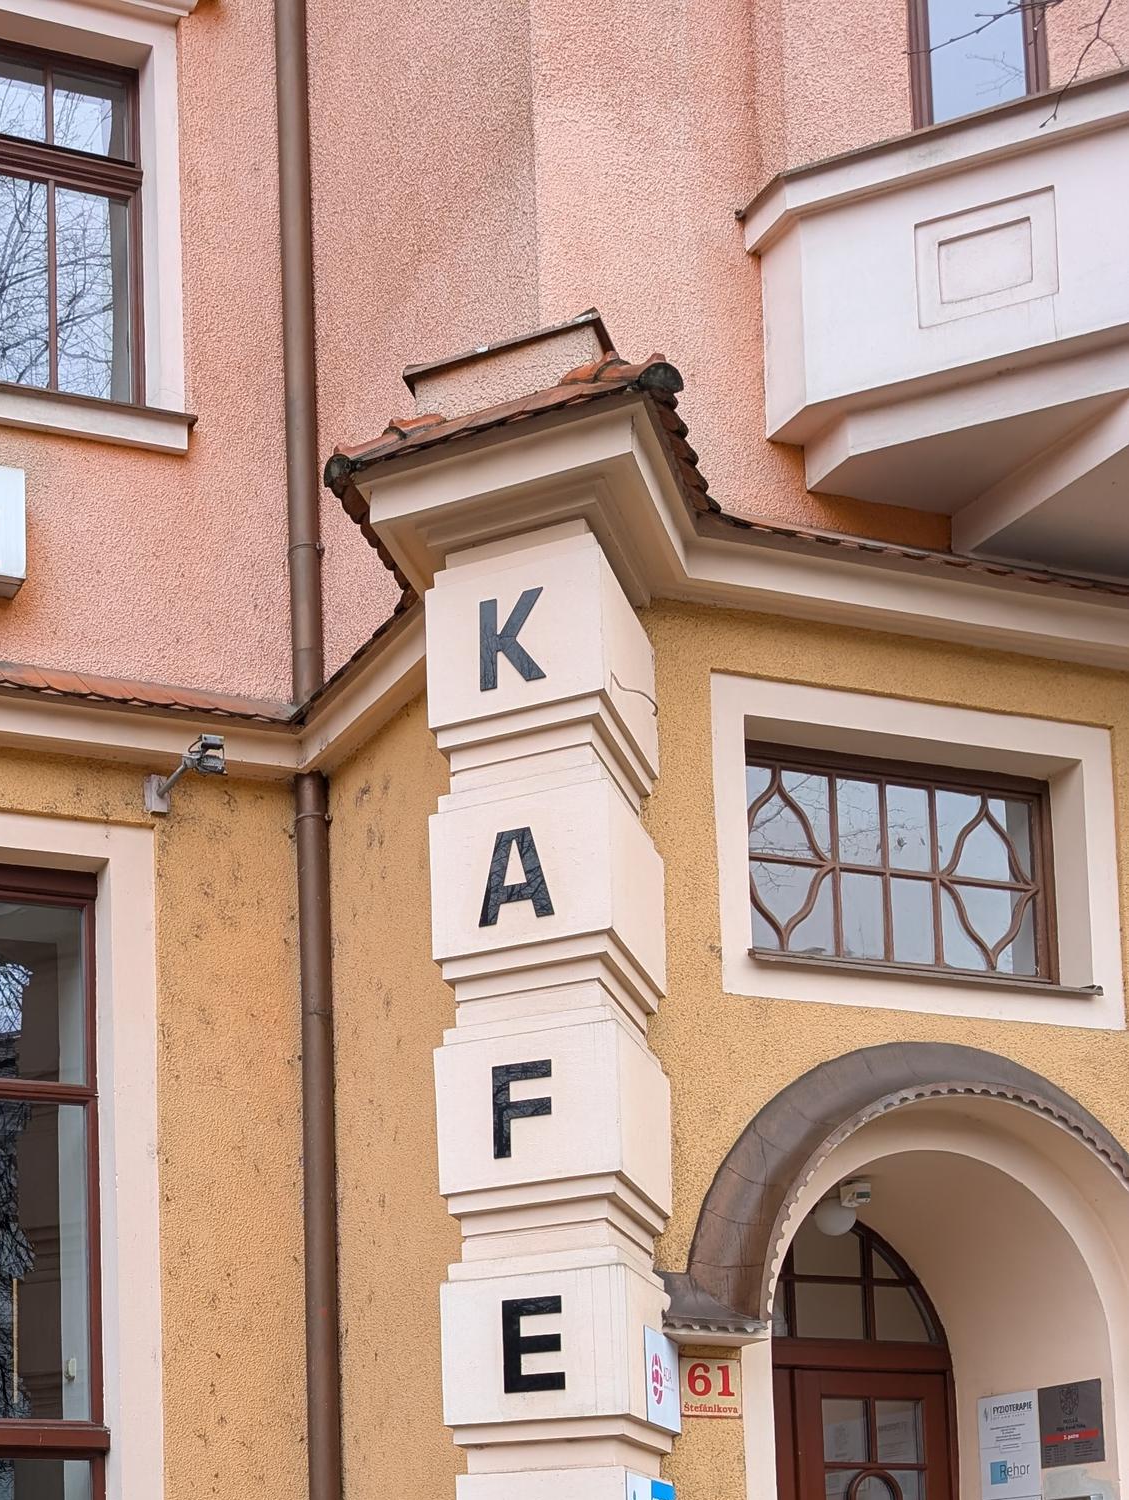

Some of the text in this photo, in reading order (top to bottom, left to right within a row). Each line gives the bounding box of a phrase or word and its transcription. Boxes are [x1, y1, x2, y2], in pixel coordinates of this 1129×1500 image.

[479, 586, 566, 1393] KAFE
[687, 1362, 735, 1397] 61
[683, 1401, 739, 1414] Štefánikova
[992, 1400, 1033, 1415] FYZIOTERAPIE
[999, 1462, 1031, 1478] Rehor
